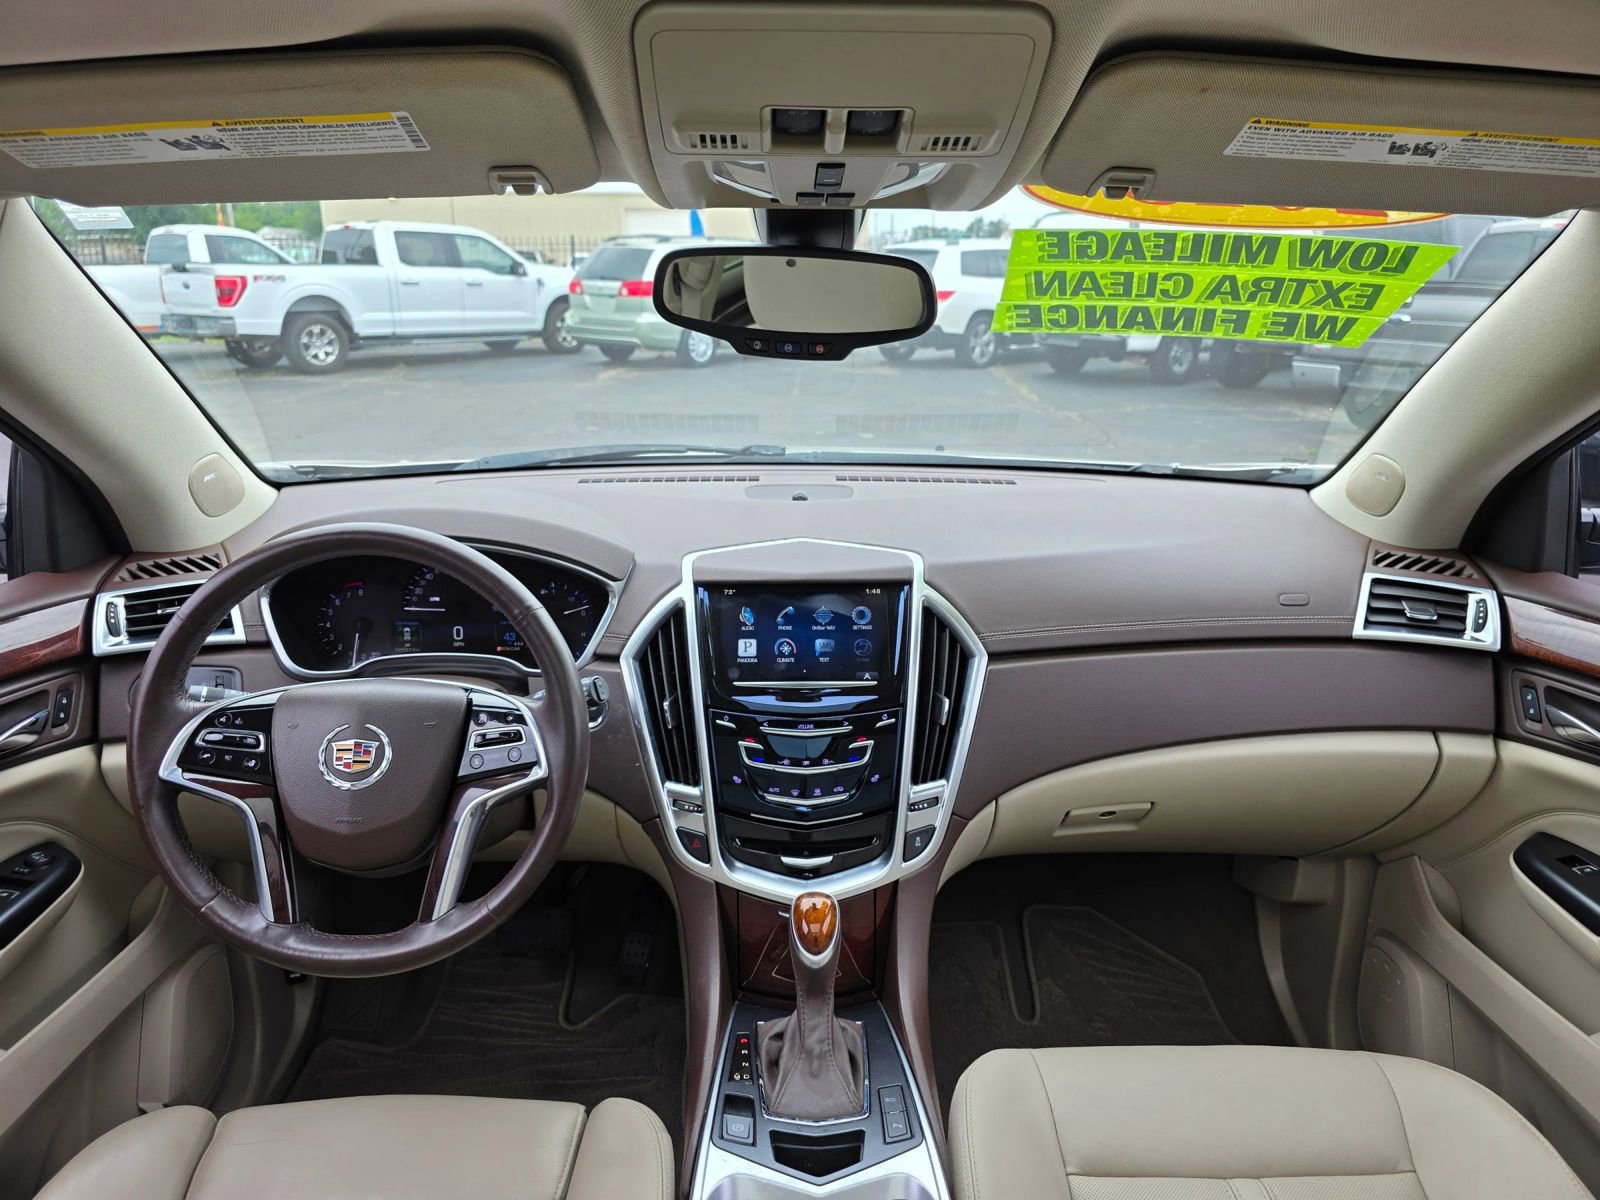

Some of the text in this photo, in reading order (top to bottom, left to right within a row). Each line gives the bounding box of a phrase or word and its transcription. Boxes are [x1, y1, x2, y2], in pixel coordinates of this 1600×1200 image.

[225, 118, 304, 127] AVERTISSEMENT
[346, 120, 396, 128] INTELLIGENTS
[1264, 119, 1310, 128] WARNING
[453, 626, 464, 640] 0
[504, 632, 516, 640] 43
